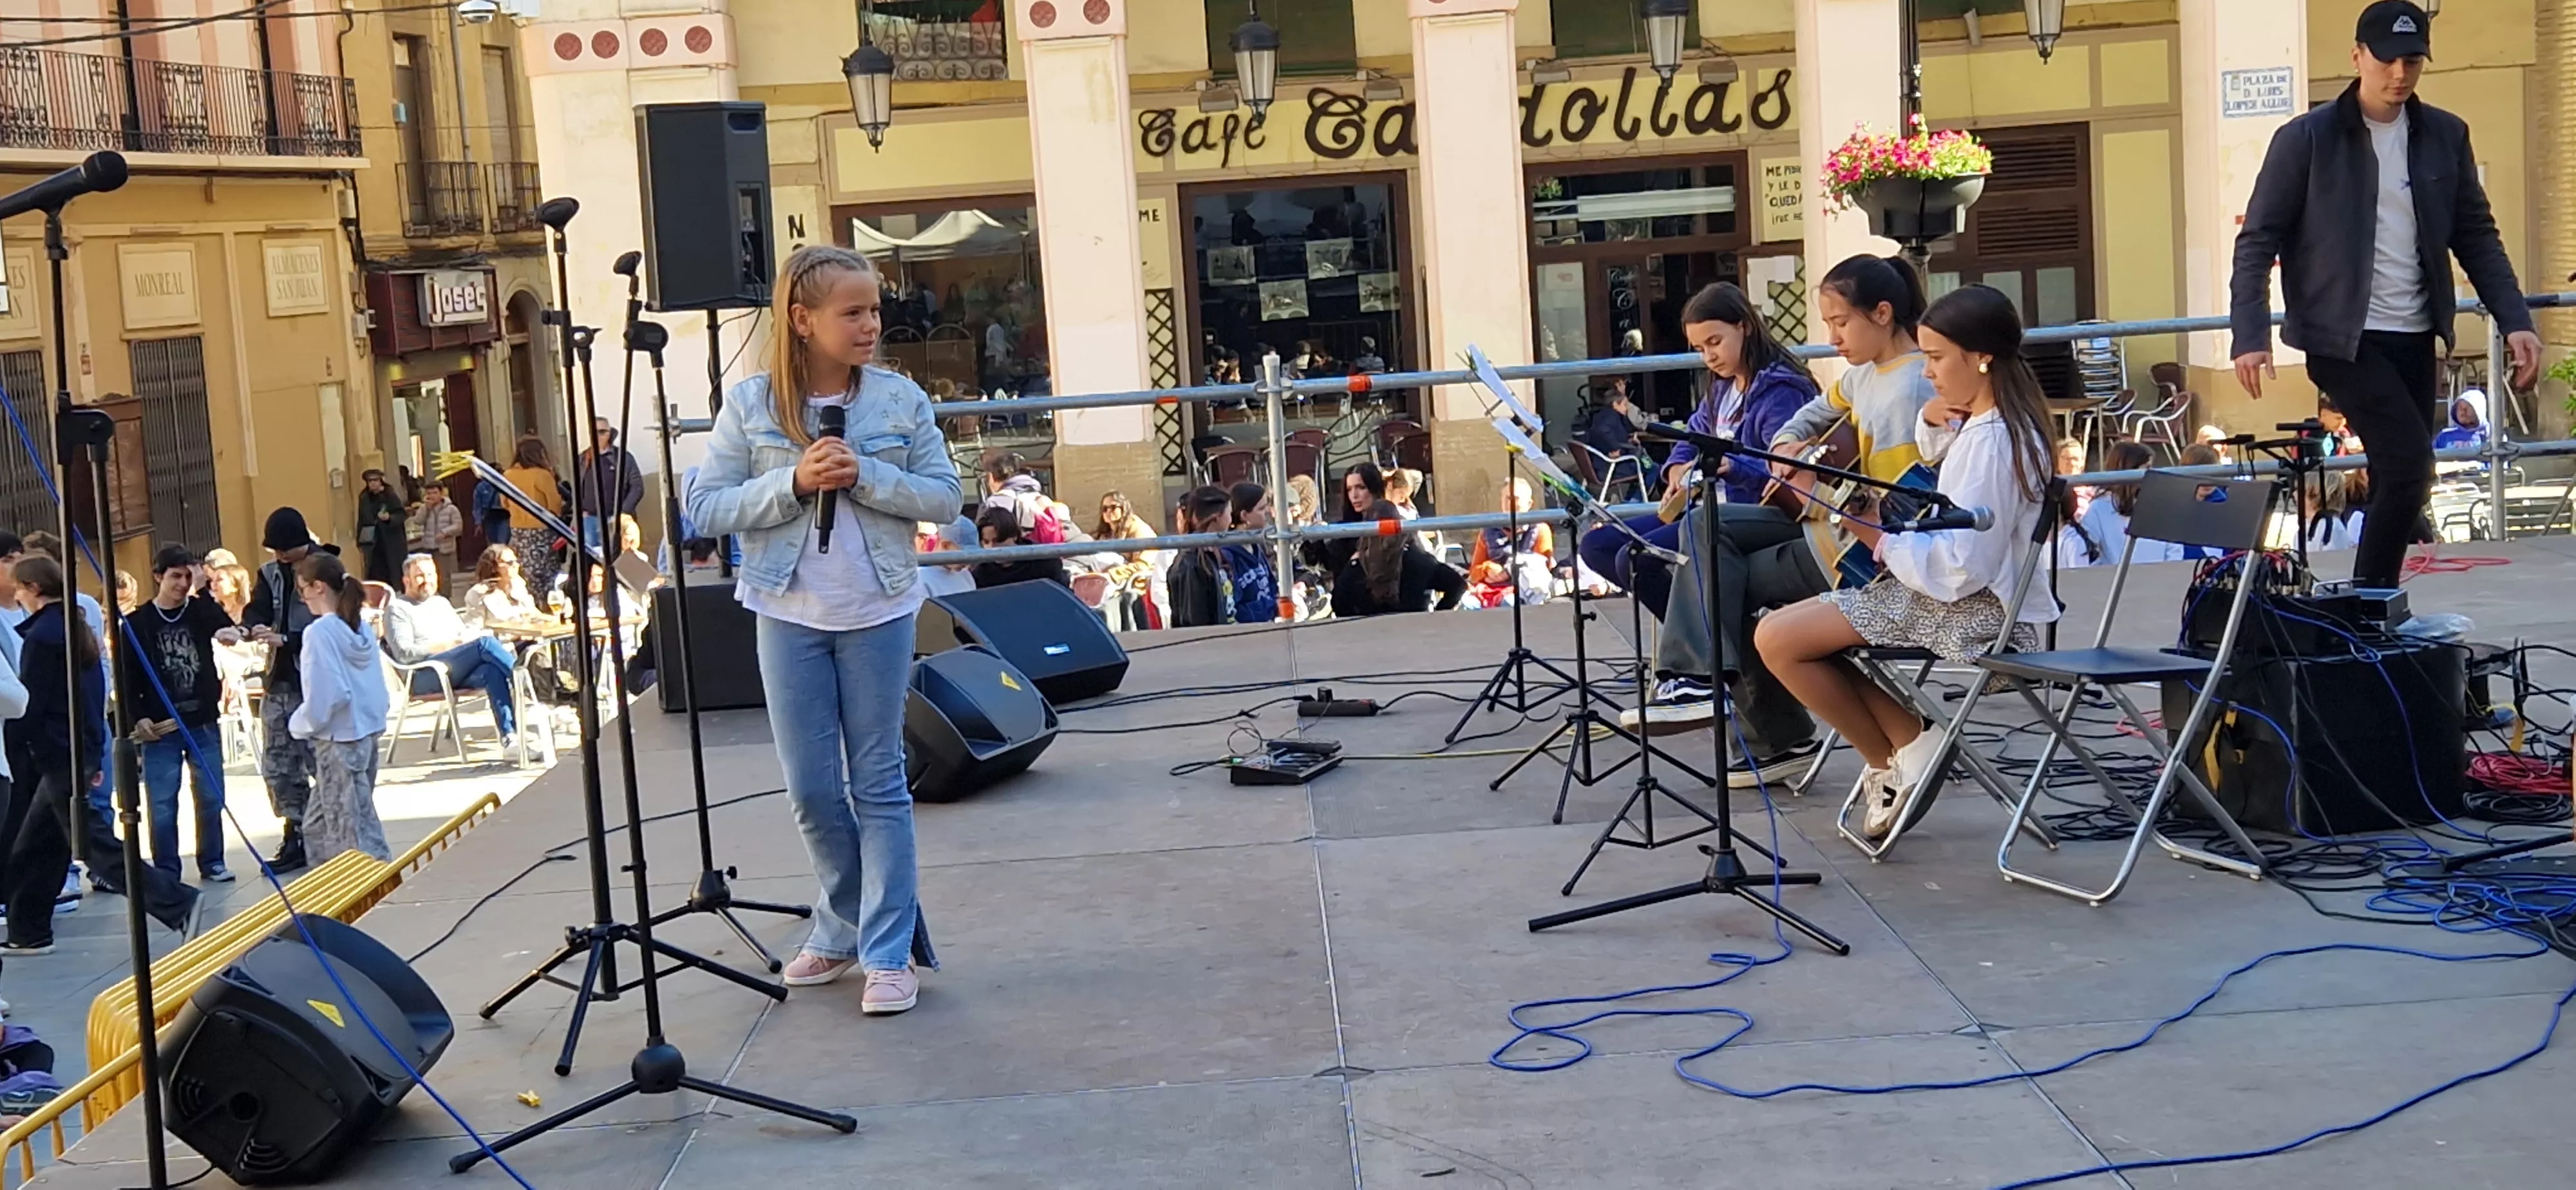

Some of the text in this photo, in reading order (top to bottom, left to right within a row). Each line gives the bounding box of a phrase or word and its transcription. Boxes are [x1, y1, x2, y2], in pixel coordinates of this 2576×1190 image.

[2243, 74, 2274, 86] PLAZA
[1766, 165, 1782, 176] ME
[1768, 181, 1774, 192] Y
[135, 272, 185, 297] MONREAL
